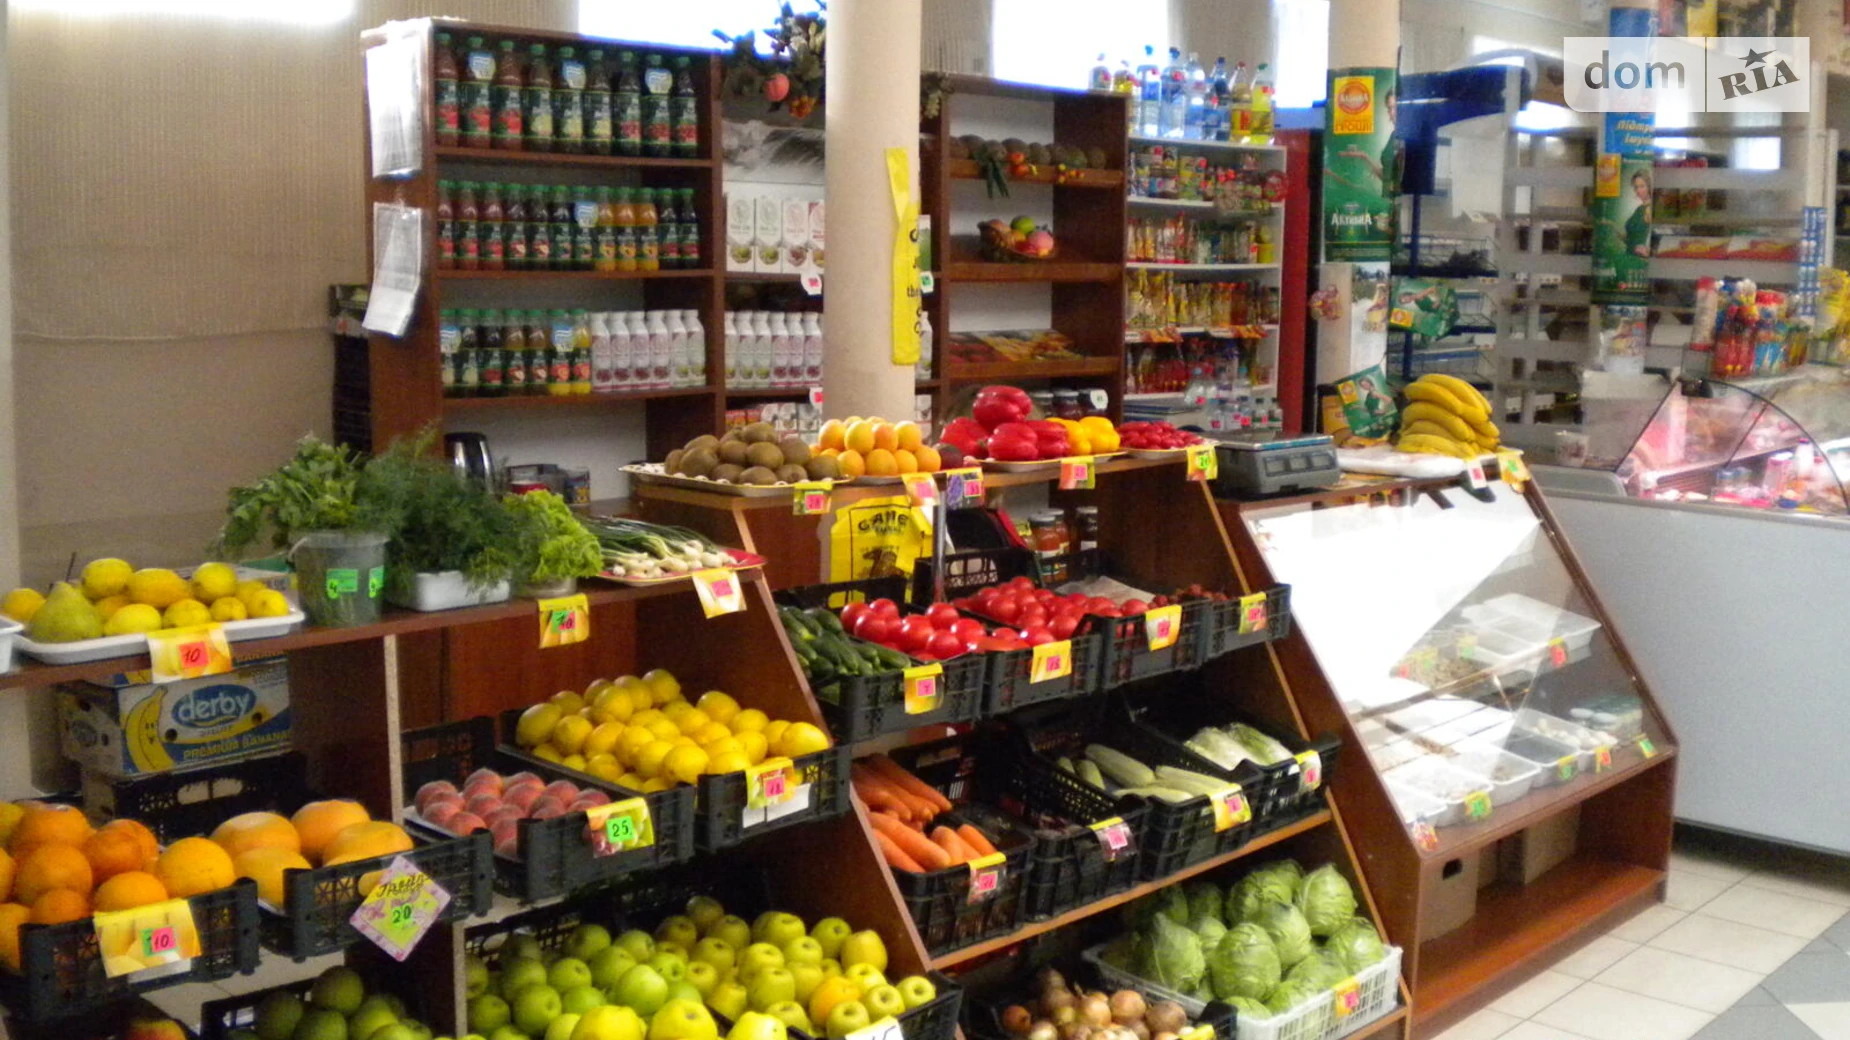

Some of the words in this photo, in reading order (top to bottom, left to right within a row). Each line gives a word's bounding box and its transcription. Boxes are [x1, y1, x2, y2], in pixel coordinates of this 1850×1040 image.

[184, 648, 201, 662] 10
[178, 690, 251, 721] derby
[611, 819, 629, 837] 25
[392, 905, 412, 924] 20
[155, 934, 170, 950] 10
